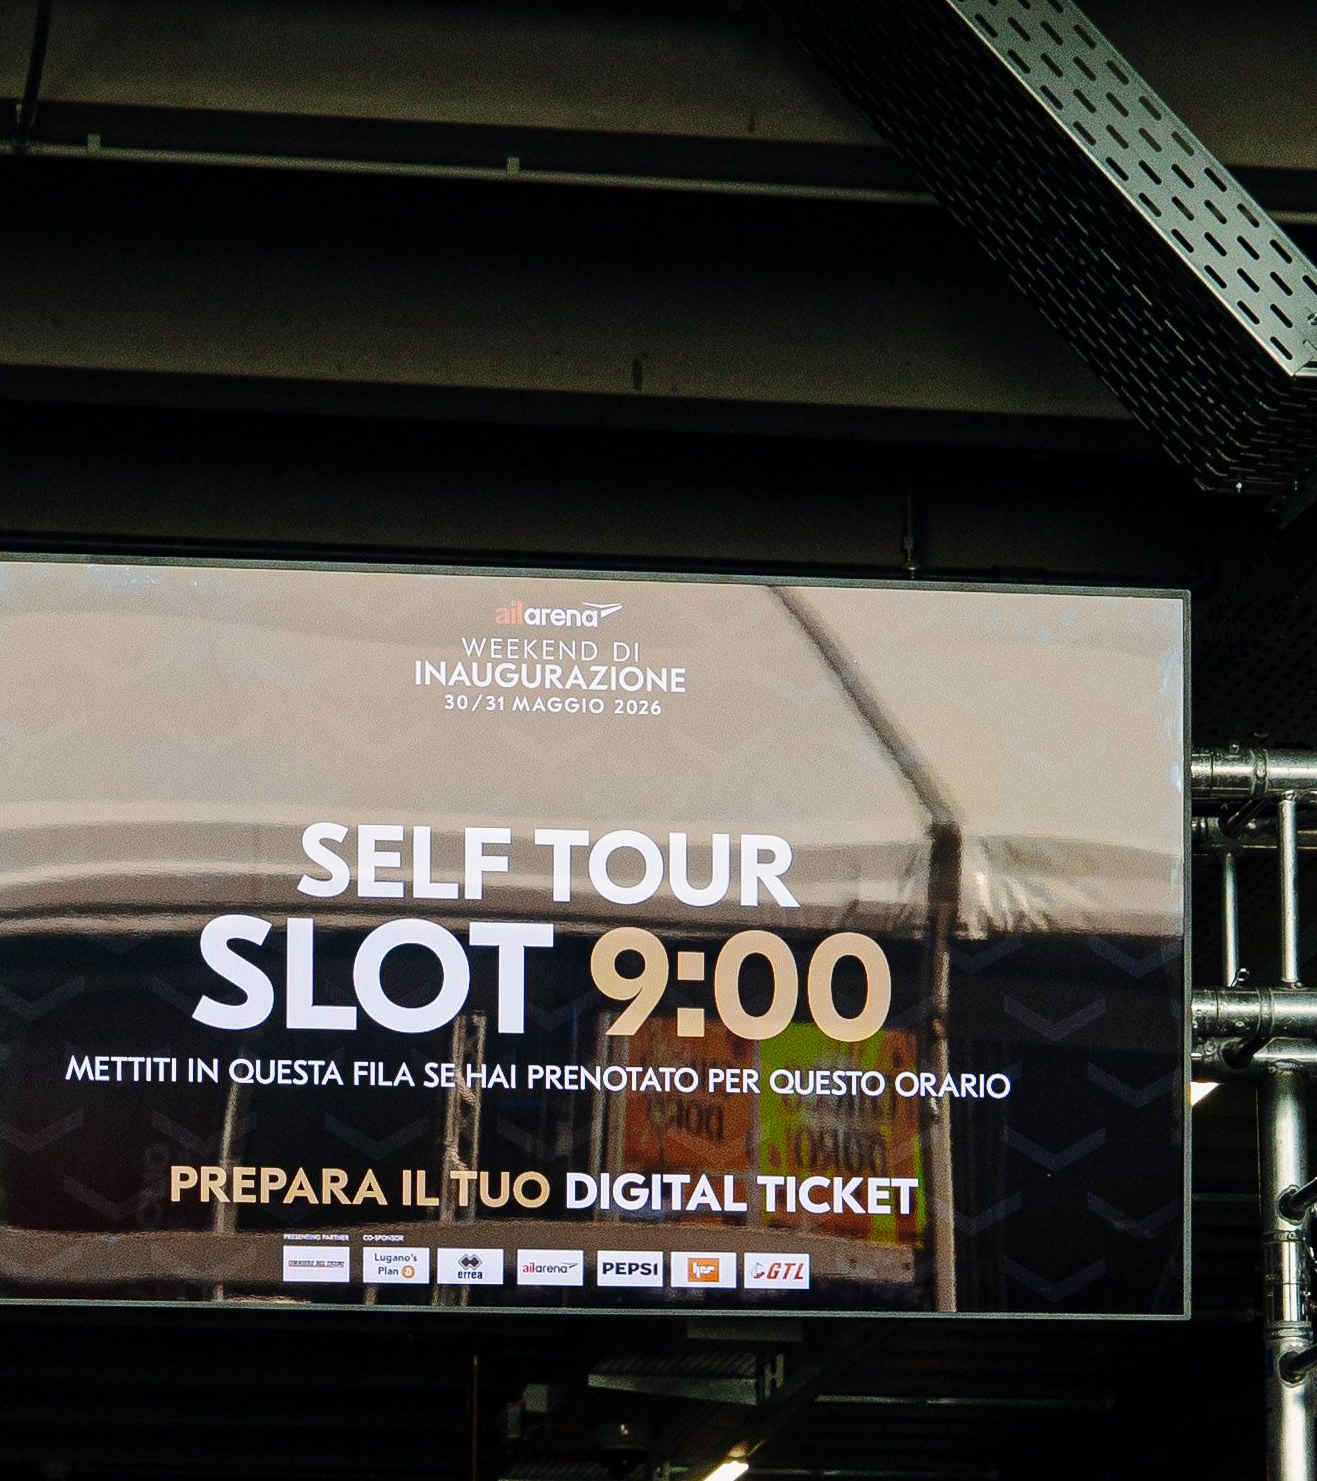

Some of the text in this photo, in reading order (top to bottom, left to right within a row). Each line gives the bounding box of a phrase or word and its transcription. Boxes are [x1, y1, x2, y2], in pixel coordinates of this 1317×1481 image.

[461, 637, 640, 663] WEEKEND DI
[415, 660, 687, 693] INAUGURAZIONE
[444, 694, 663, 716] 30/31 MAGGIO 2026
[296, 821, 801, 908] SELF TOUR
[191, 914, 893, 1043] SLOT 9:00
[65, 1055, 1012, 1100] METTITI IN QUESTA FILA SE HAI PRENOTATO PER QUESTO ORARIO
[170, 1165, 920, 1215] PREPARA IL TUO DIGITAL TICKET
[374, 1252, 418, 1264] Lugano's
[377, 1266, 400, 1276] Plan
[602, 1261, 658, 1276] PEPSI
[766, 1262, 804, 1280] GTL
